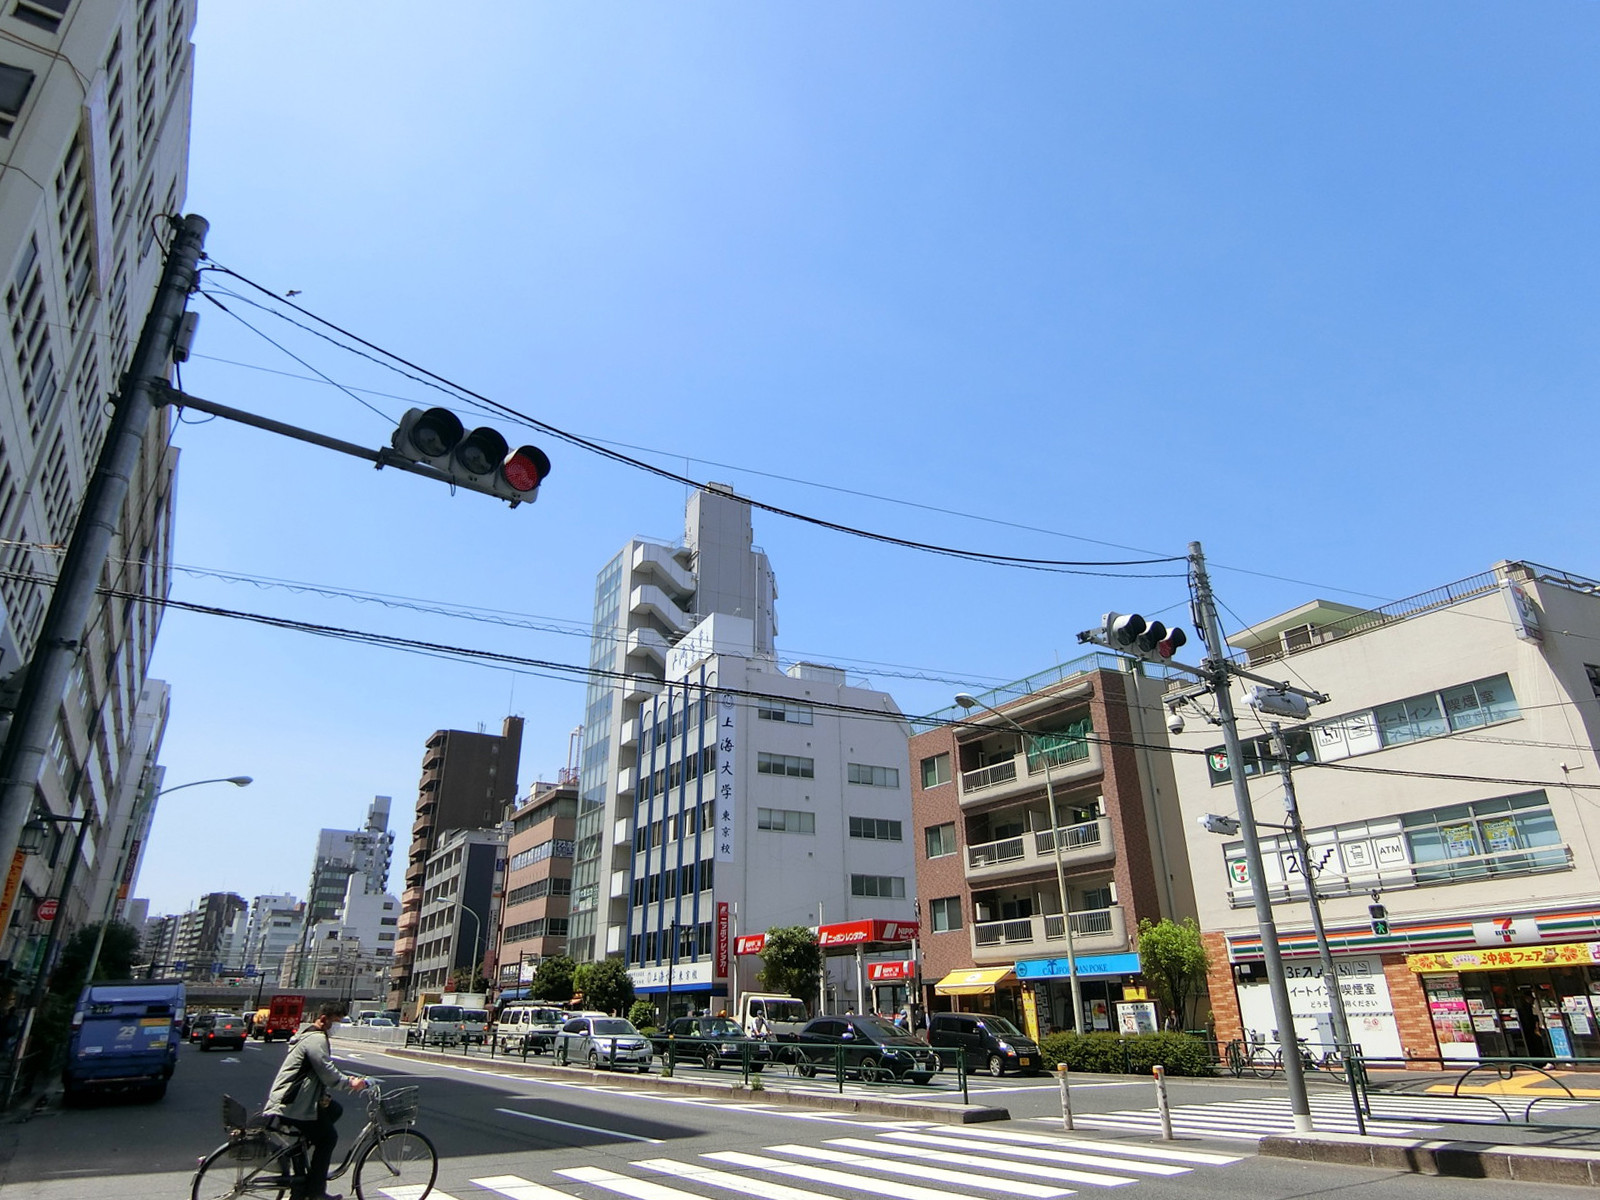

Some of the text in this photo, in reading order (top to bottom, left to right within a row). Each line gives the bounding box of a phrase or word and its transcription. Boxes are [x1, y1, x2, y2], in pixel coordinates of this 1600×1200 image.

[1380, 844, 1401, 855] ATM
[1480, 951, 1544, 966] 沖縄フェア
[119, 1026, 137, 1037] 23
